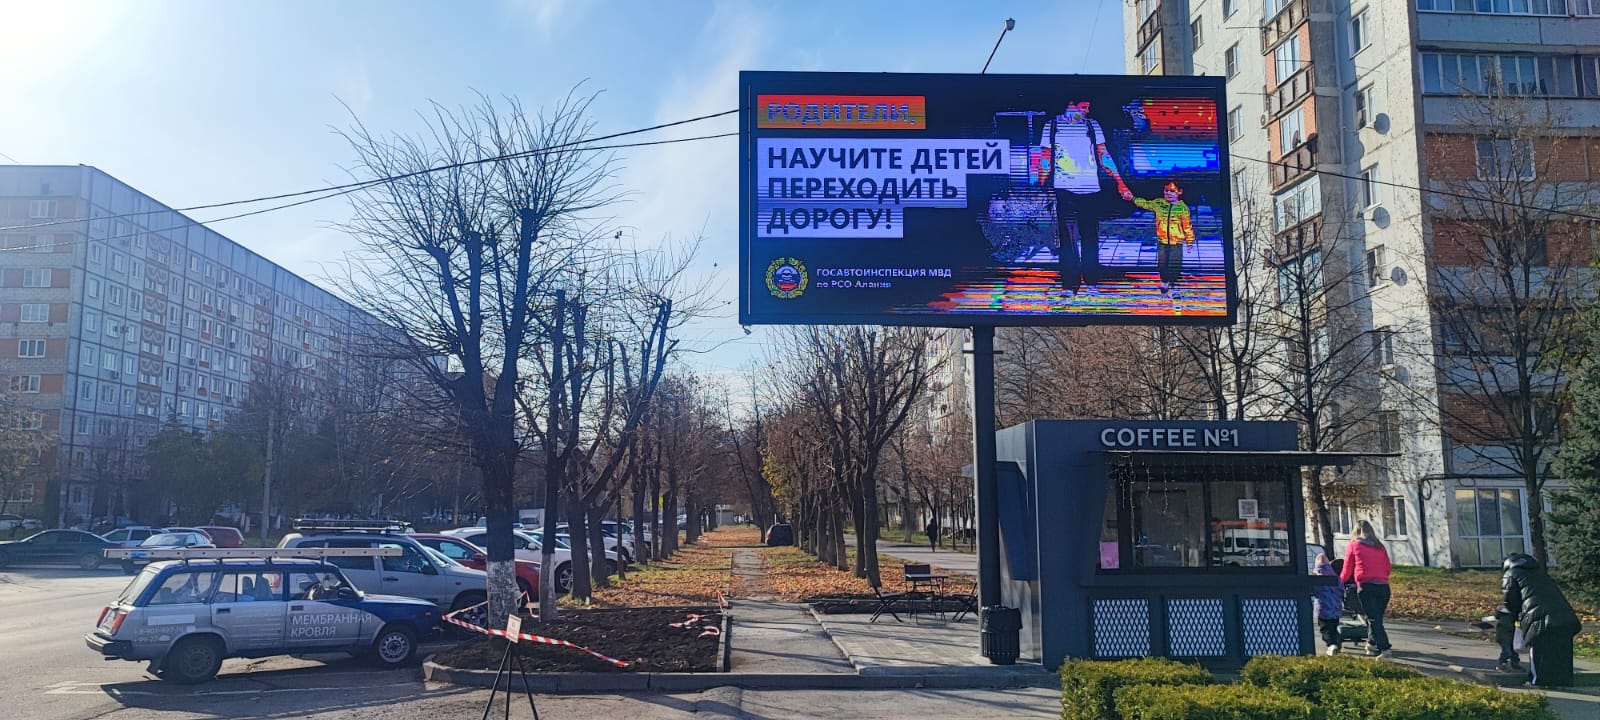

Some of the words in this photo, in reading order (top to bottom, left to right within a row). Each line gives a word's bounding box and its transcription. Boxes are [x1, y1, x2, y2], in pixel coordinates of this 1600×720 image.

[767, 103, 915, 125] РОДИТЕЛИ,
[768, 147, 902, 170] НАУЧИТЕ
[911, 142, 1002, 174] ДЕТЕЙ
[768, 177, 958, 204] ПЕРЕХОДИТЬ
[766, 208, 891, 234] ДОРОГУ!
[816, 268, 926, 278] ГОСАВТОИНСПЕКЦИЯ
[928, 268, 952, 278] МВД
[1101, 428, 1197, 447] COFFEE
[292, 613, 372, 625] МЕМБРАННАЯ
[291, 626, 336, 638] КРОВЛЯ
